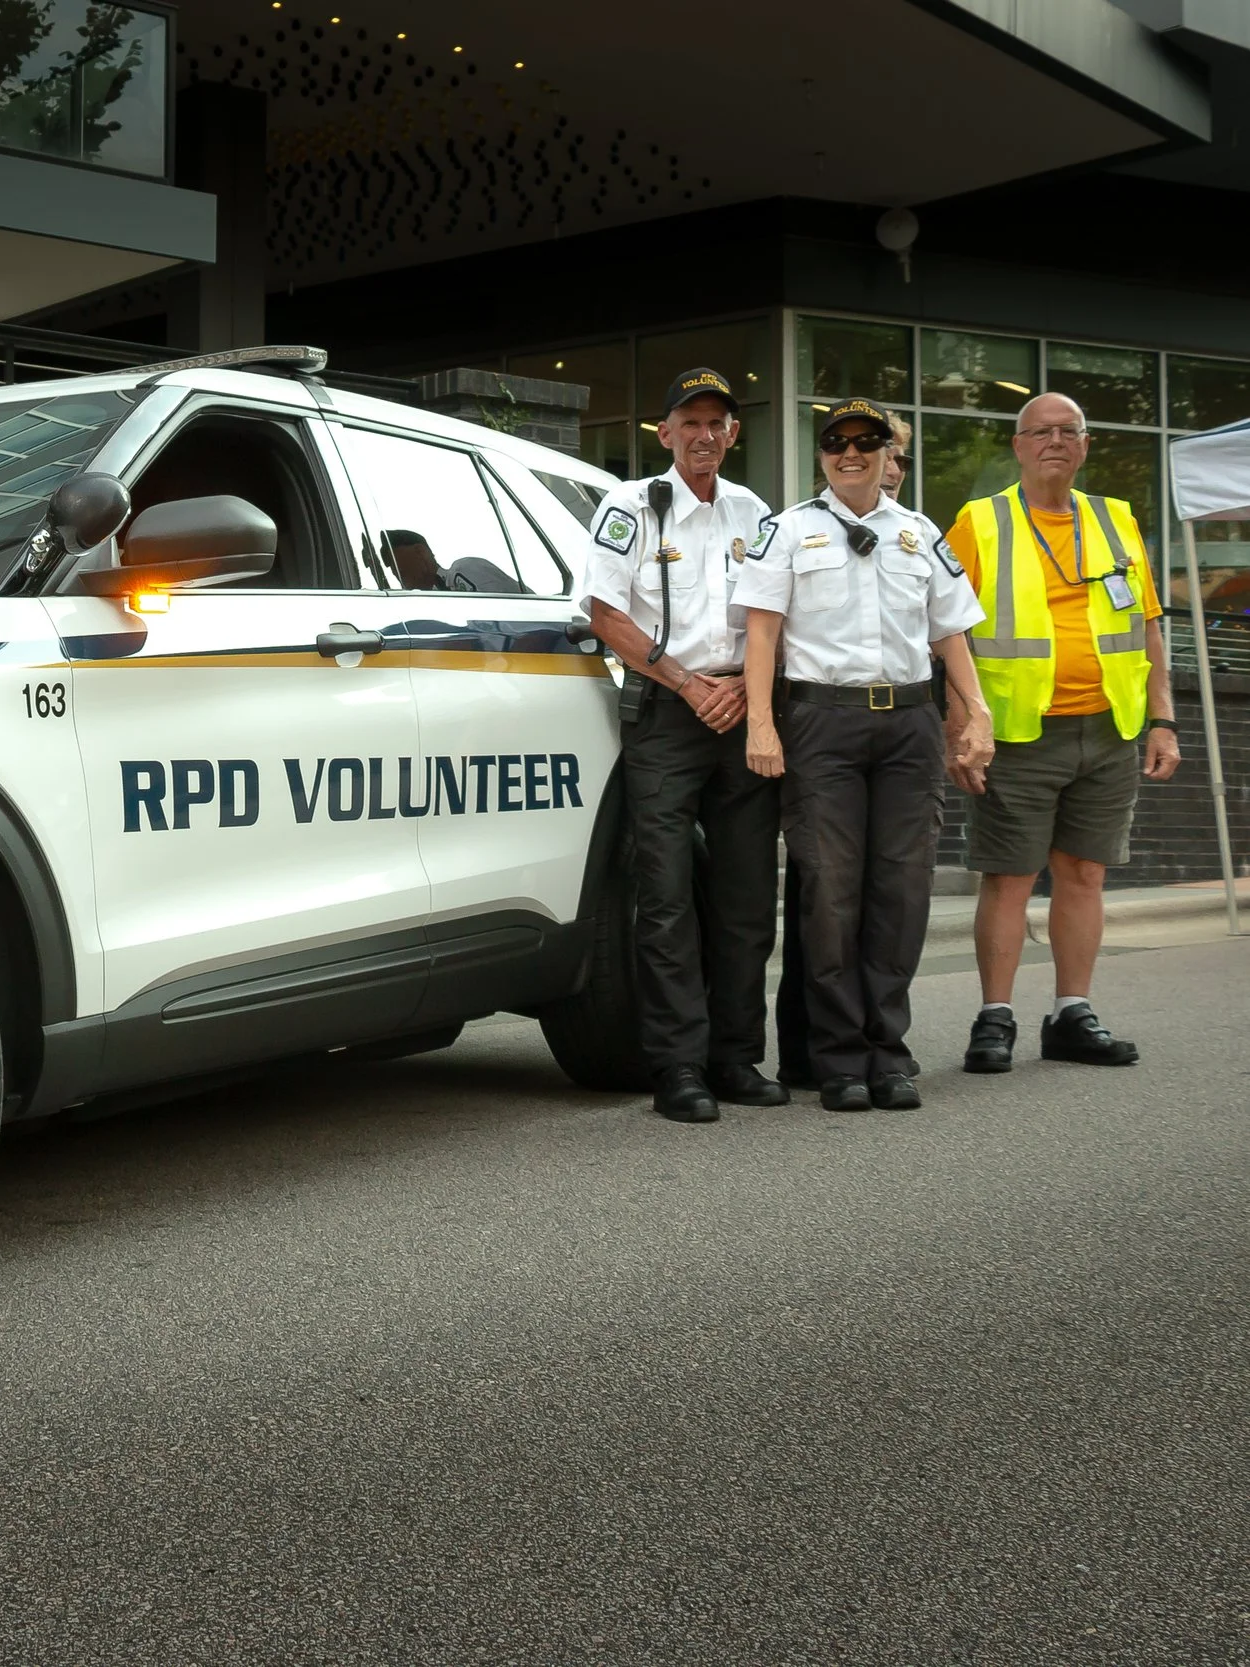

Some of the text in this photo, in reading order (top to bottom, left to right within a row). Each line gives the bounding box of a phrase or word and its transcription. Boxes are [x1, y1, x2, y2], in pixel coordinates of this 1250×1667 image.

[22, 682, 66, 719] 163
[119, 753, 584, 833] RPD VOLUNTEER
